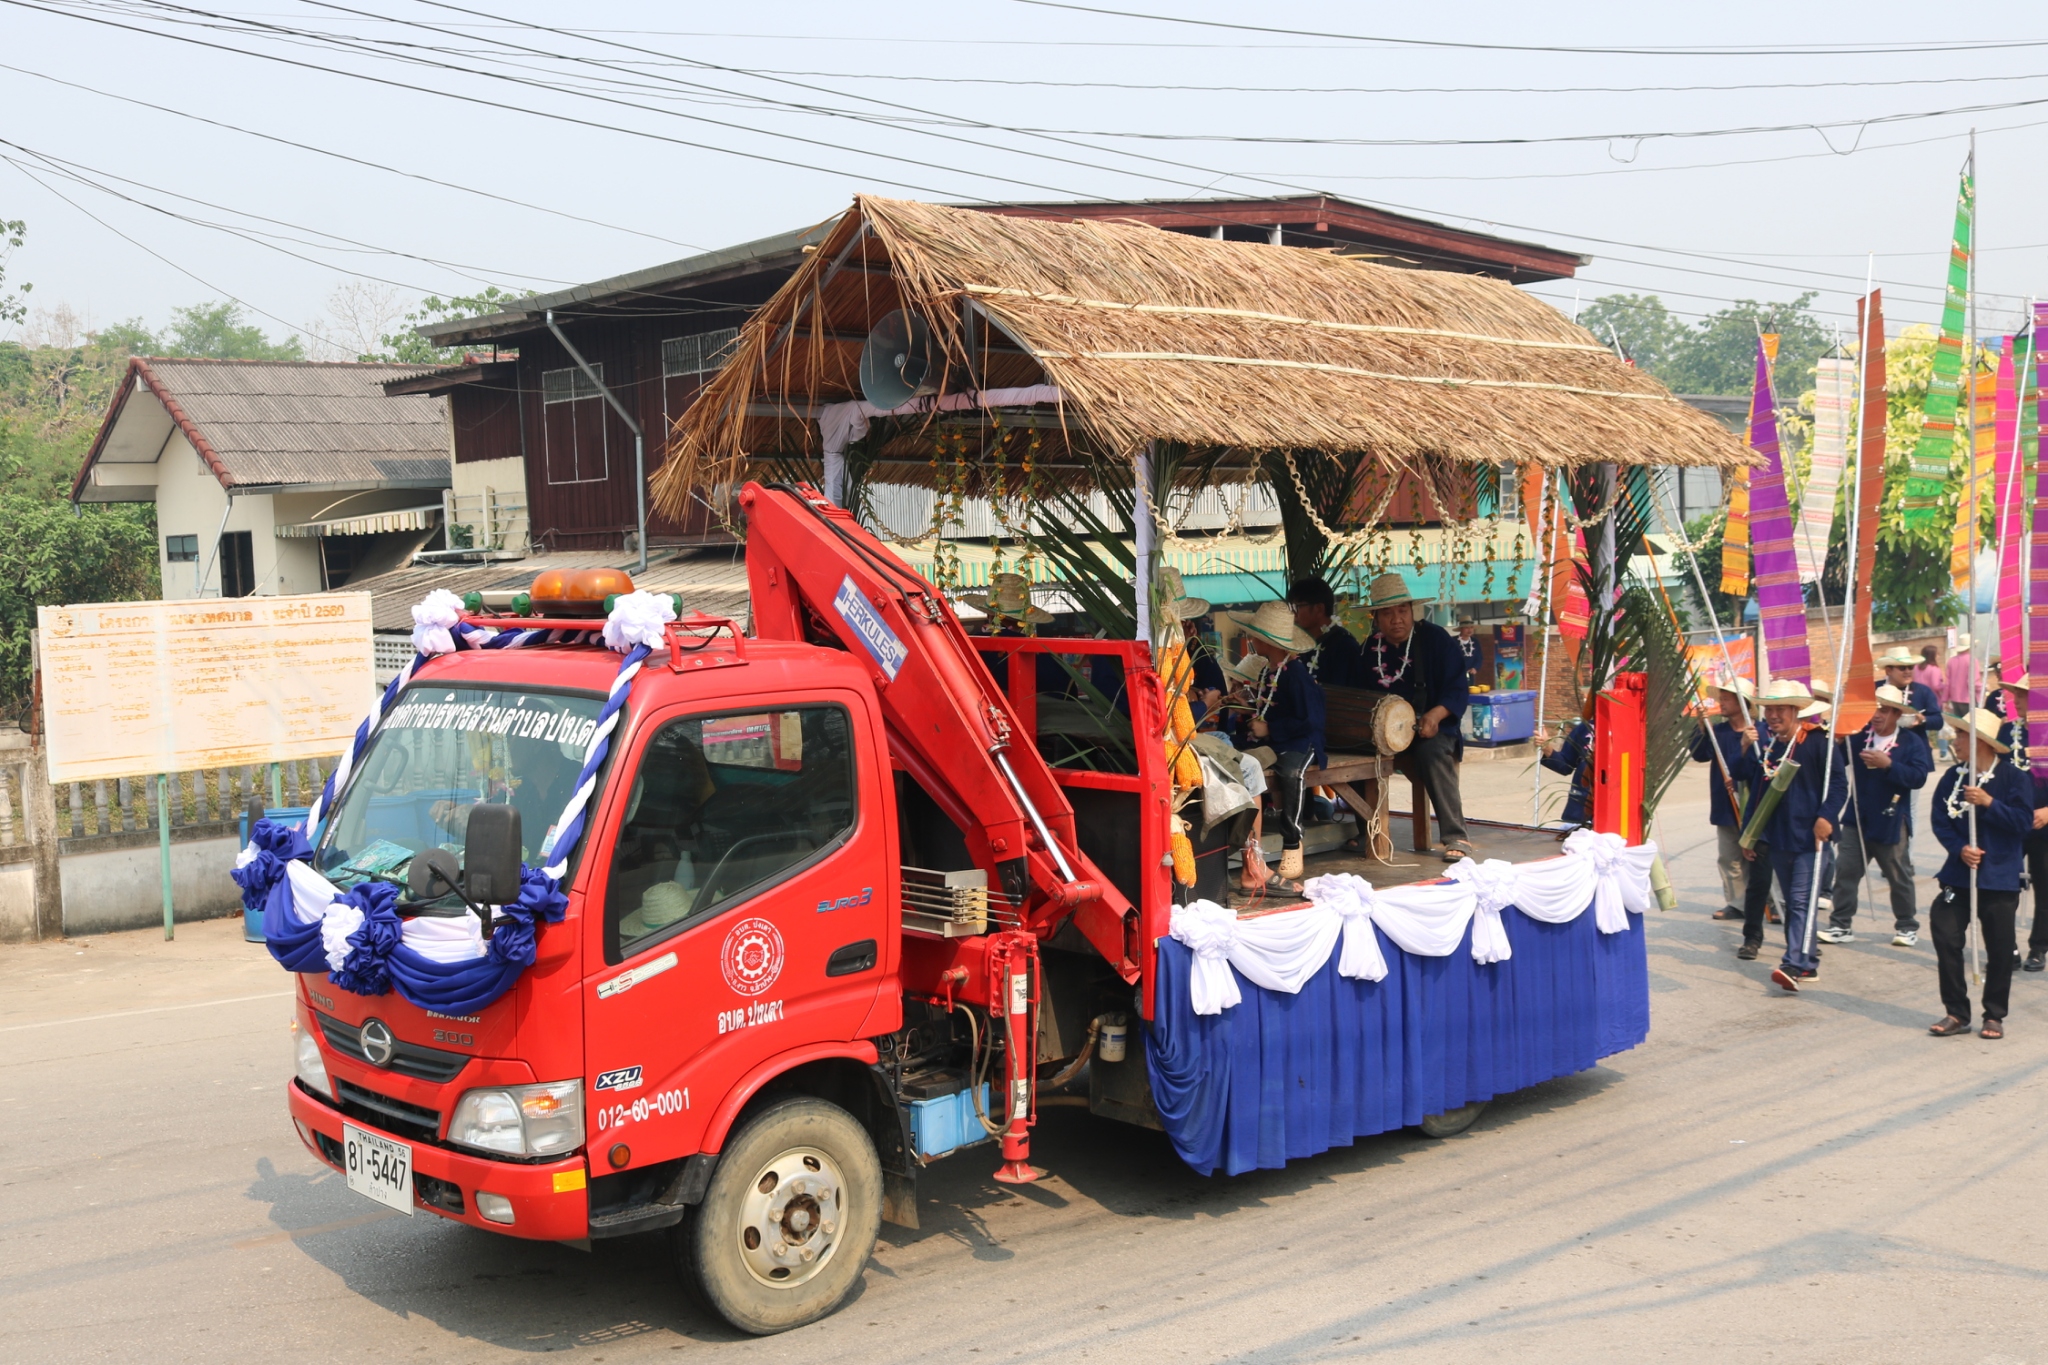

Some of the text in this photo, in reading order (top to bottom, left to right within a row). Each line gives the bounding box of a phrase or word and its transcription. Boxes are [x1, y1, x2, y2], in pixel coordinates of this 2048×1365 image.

[842, 590, 897, 663] HERKULES
[308, 988, 335, 1011] HINO
[432, 1029, 474, 1046] 300
[598, 1069, 638, 1088] XZU
[598, 1087, 690, 1131] 012-60-0001
[358, 1132, 395, 1153] THAILAND
[348, 1140, 406, 1192] 81-5447
